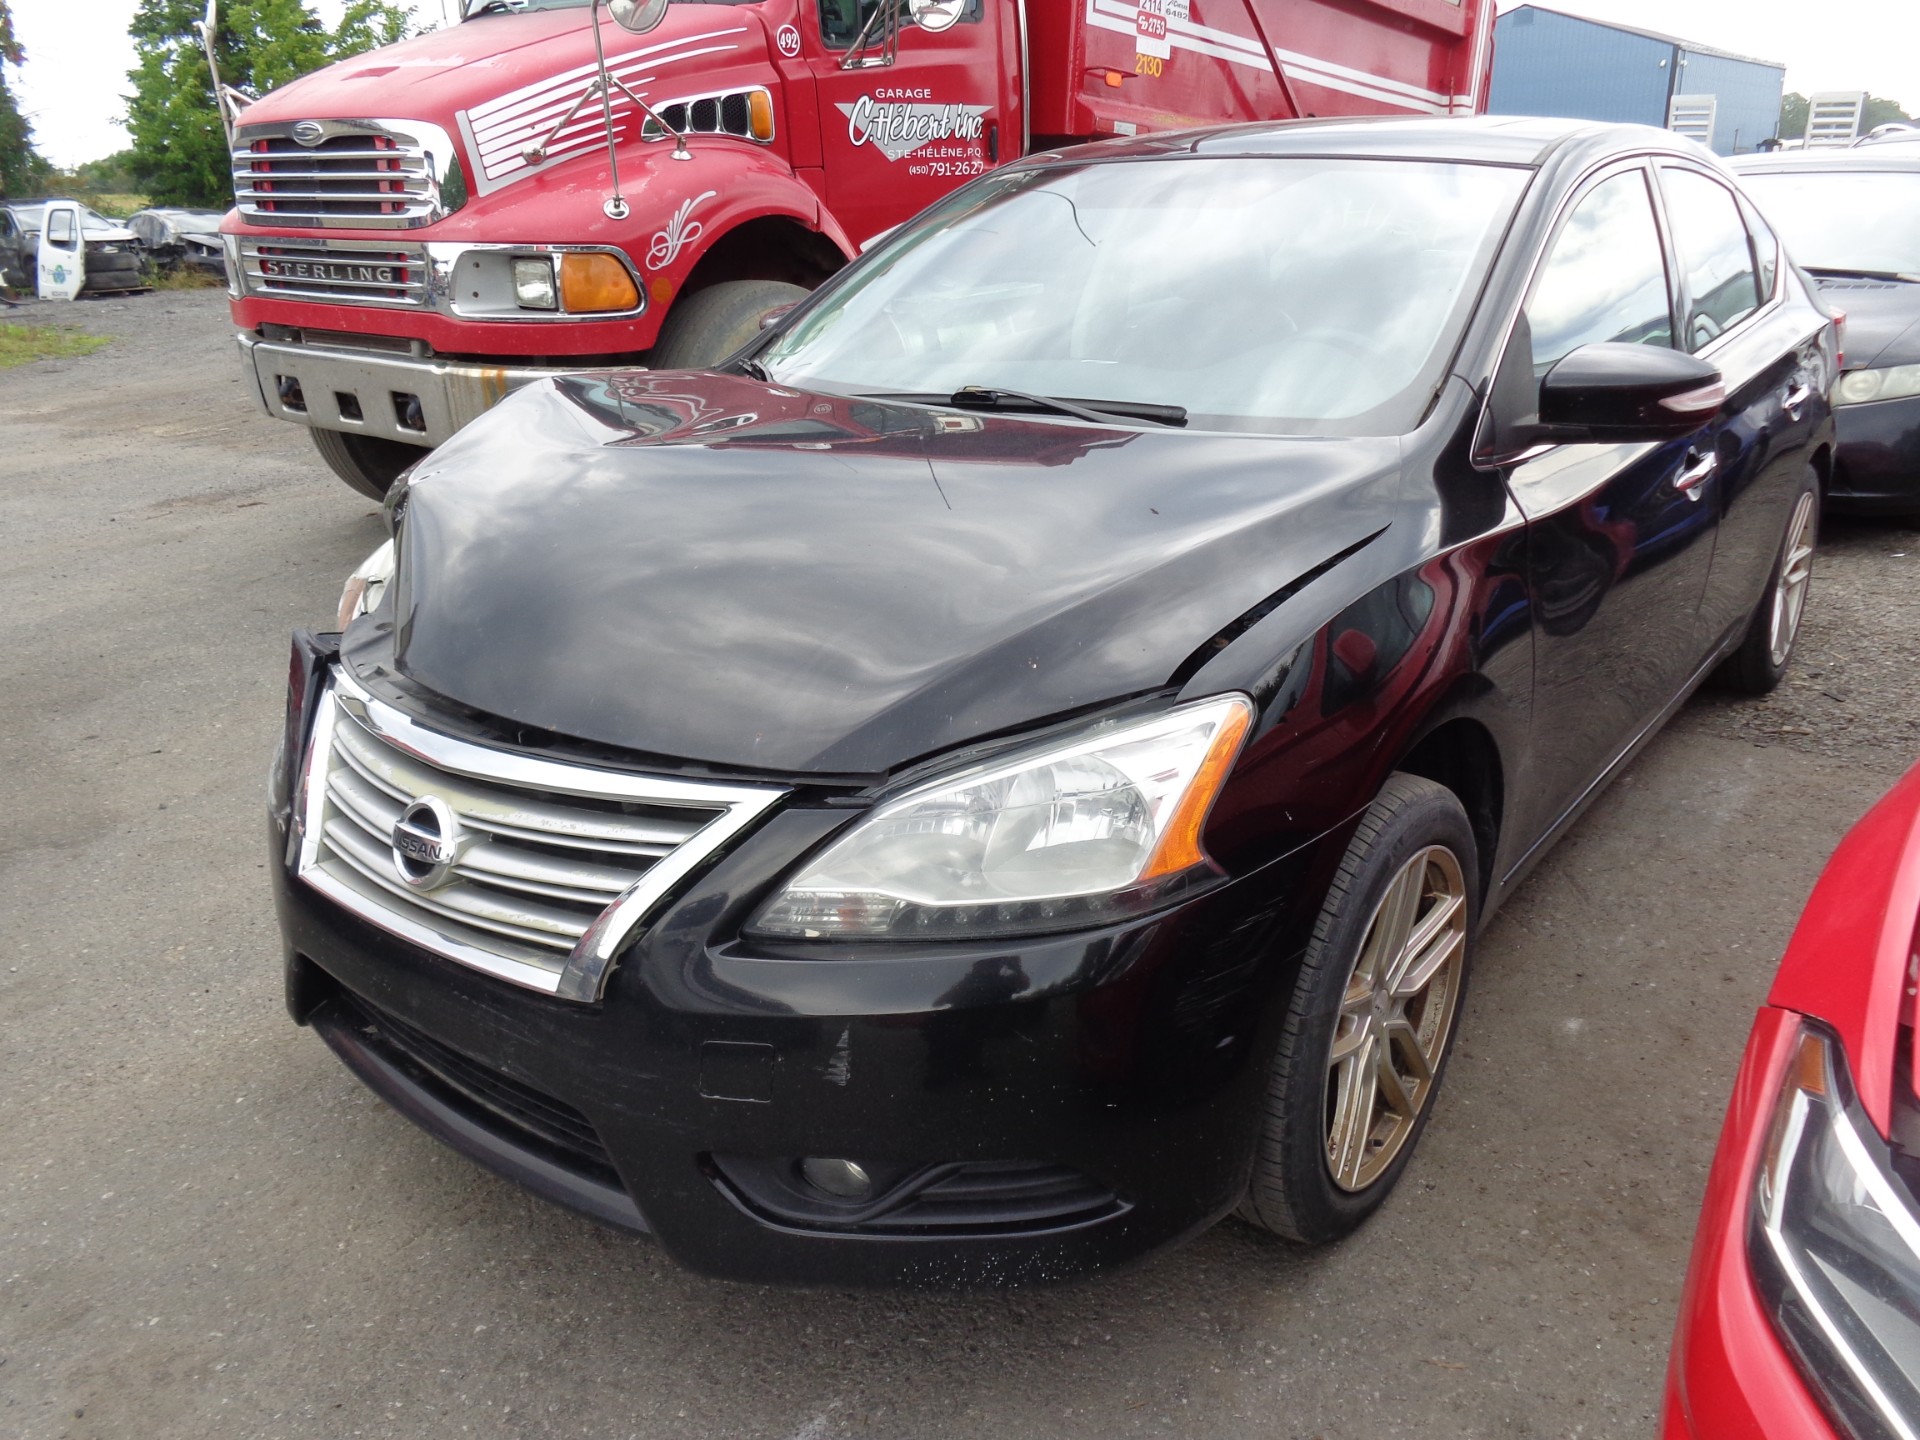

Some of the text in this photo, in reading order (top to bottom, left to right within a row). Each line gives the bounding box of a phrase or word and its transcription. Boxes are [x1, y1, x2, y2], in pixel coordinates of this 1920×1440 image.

[1148, 17, 1165, 36] 2753
[780, 33, 797, 48] 492
[1135, 53, 1162, 77] 2130
[875, 88, 931, 98] GARAGE
[267, 260, 392, 282] STERLING
